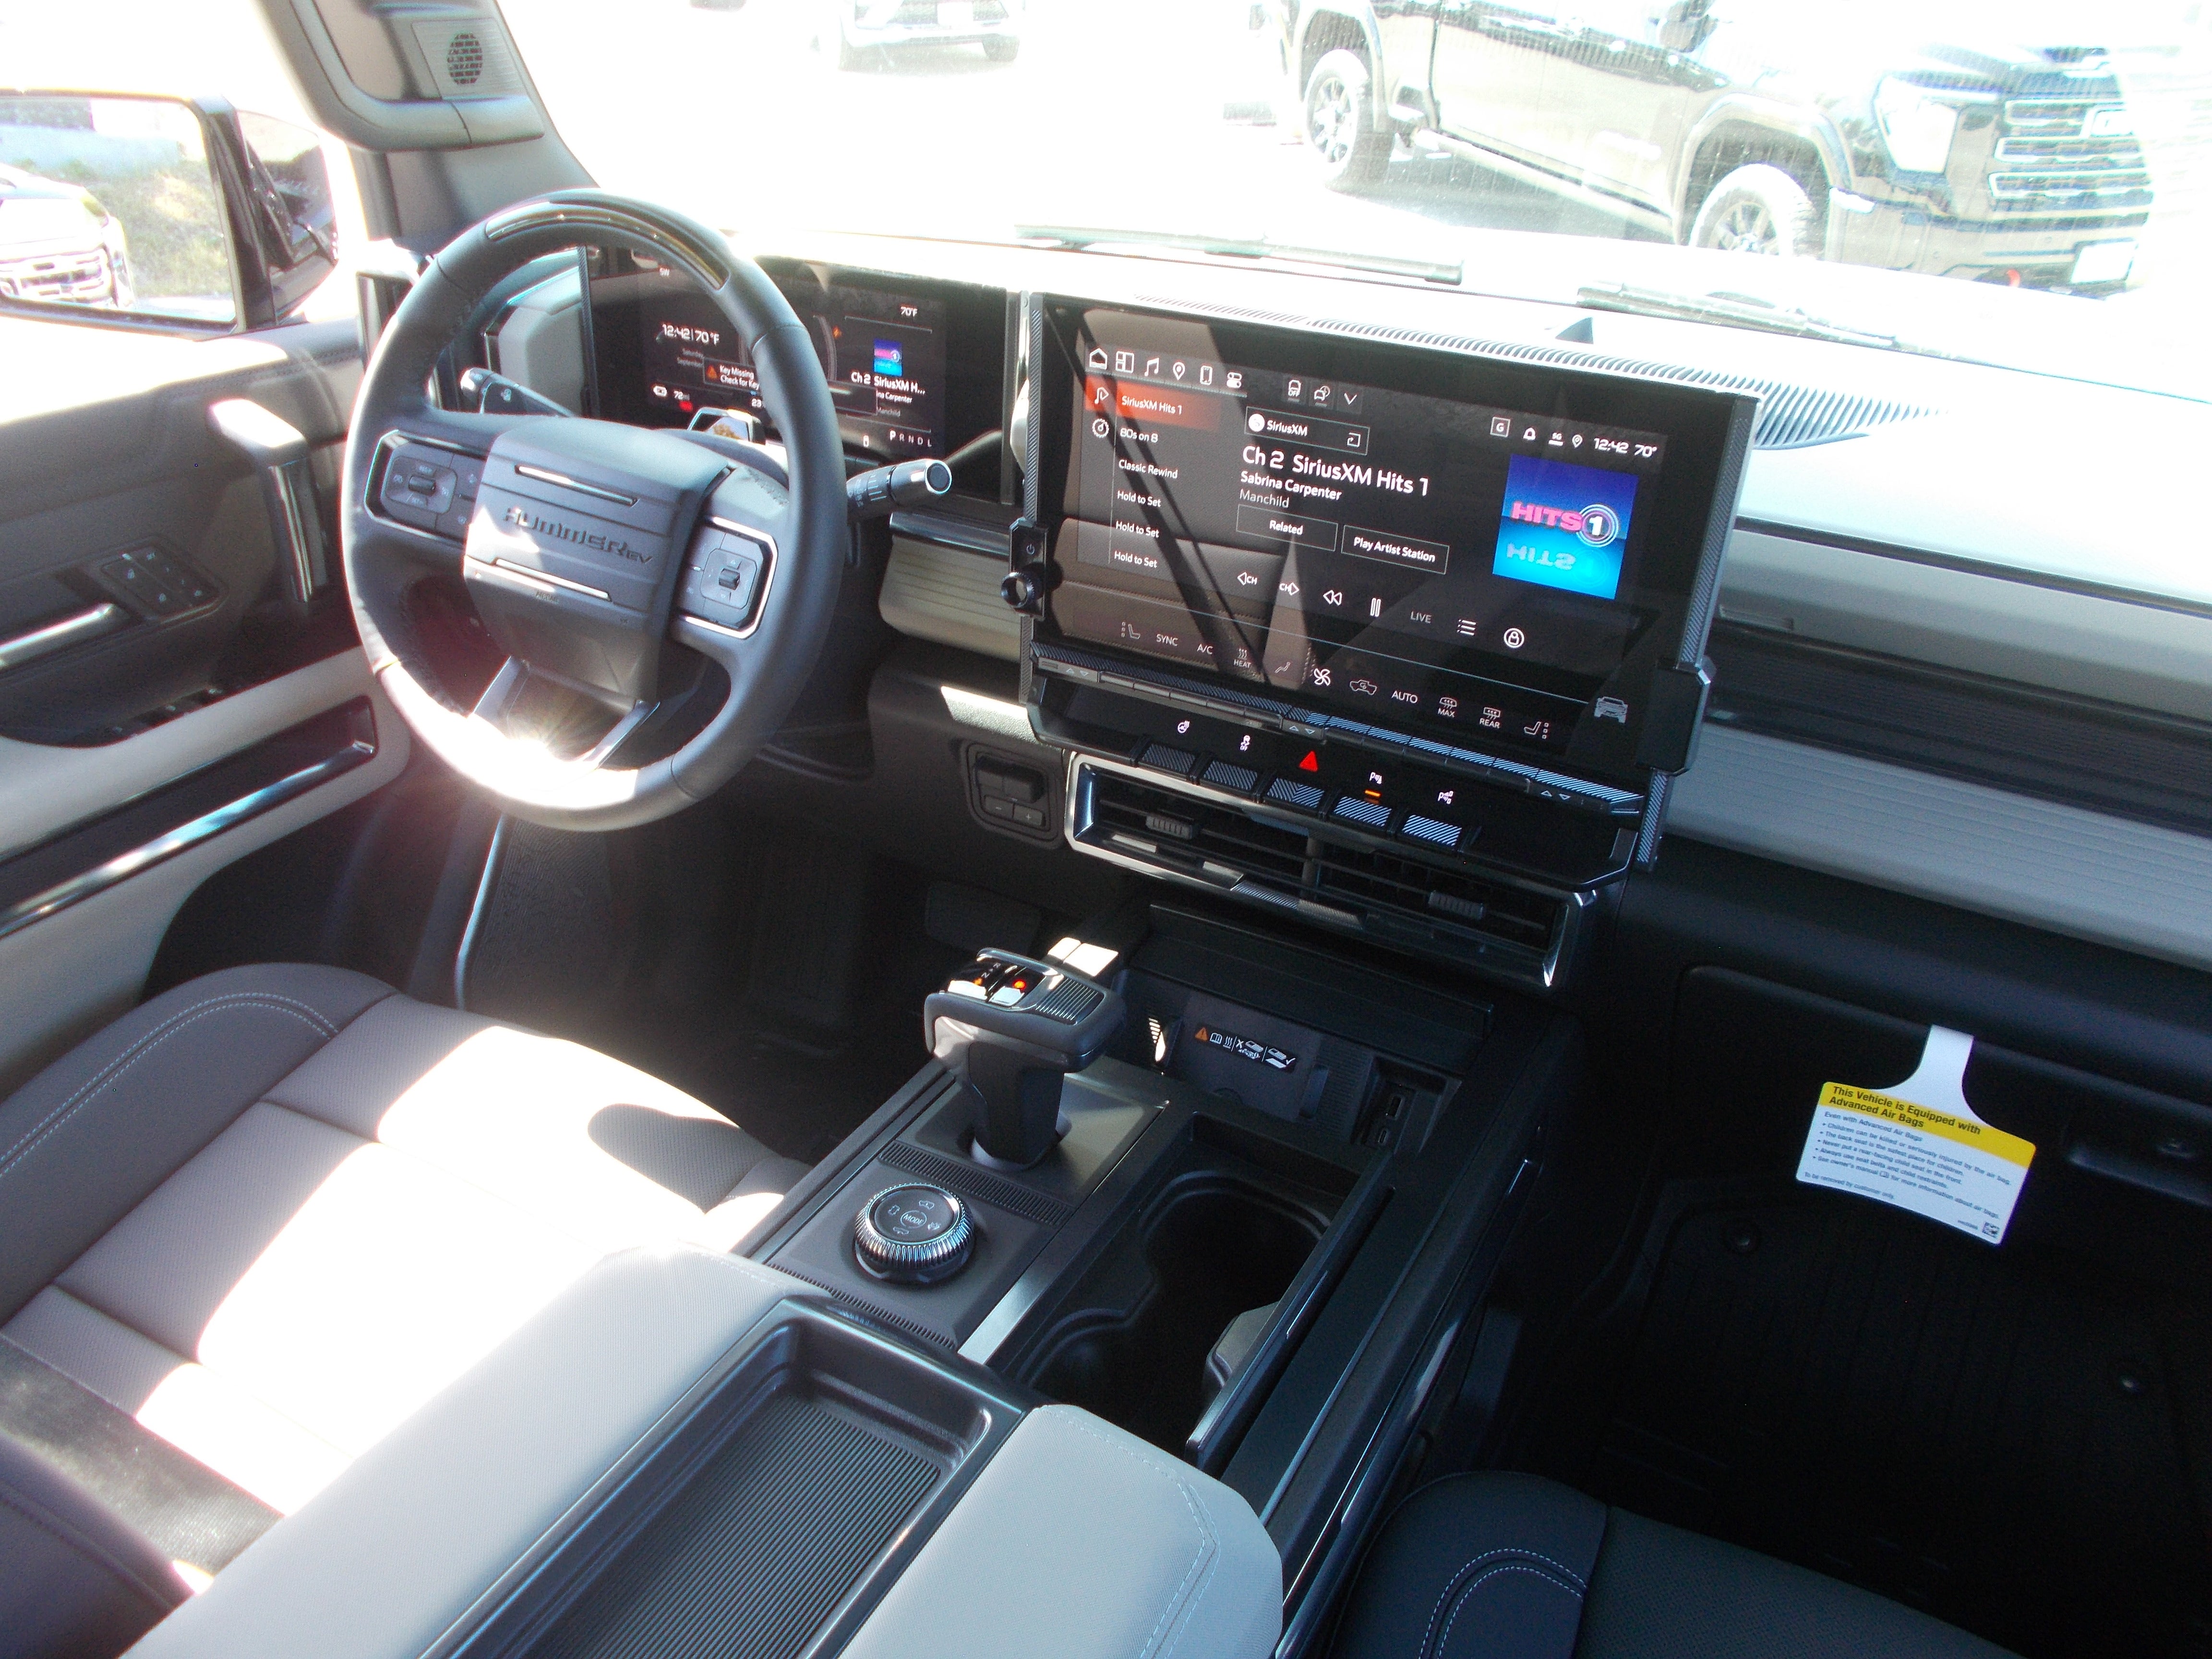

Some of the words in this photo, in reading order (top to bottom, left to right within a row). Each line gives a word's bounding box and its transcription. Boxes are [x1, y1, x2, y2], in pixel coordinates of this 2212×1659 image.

[720, 374, 738, 385] Check
[739, 377, 747, 386] for
[732, 367, 755, 380] Missing
[851, 372, 863, 383] Ch
[864, 374, 871, 384] 2
[874, 375, 909, 391] SiriusXM
[885, 392, 913, 403] Carpenter
[1121, 396, 1157, 411] SiriusXM
[1159, 400, 1176, 414] Hits
[1178, 404, 1182, 414] 1
[1120, 427, 1137, 440] 80s
[1139, 433, 1150, 442] on
[1151, 432, 1158, 443] 8
[1267, 419, 1308, 437] SiriusXM
[1496, 422, 1504, 432] G
[890, 430, 896, 441] P
[899, 433, 905, 442] R
[917, 437, 923, 445] D
[927, 439, 932, 447] L
[1594, 438, 1629, 454] 12:42
[1118, 458, 1146, 474] Classic
[1148, 463, 1178, 479] Rewind
[1243, 445, 1266, 466] Ch
[1270, 450, 1284, 469] 2
[1292, 454, 1371, 486] SiriusXM
[1377, 469, 1414, 494] Hits
[1419, 477, 1430, 497] 1
[1240, 471, 1282, 490] Sabrina
[1285, 480, 1342, 501] Carpenter
[1117, 490, 1135, 502] Hold
[1137, 494, 1145, 504] to
[1147, 495, 1161, 508] Set
[1239, 488, 1290, 508] Manchild
[1511, 501, 1583, 532] HITS
[1589, 515, 1603, 537] 1
[1116, 520, 1134, 533] Hold
[1135, 525, 1144, 536] to
[1145, 526, 1159, 538] Set
[1269, 520, 1304, 536] Related
[1353, 537, 1374, 553] Play
[1374, 541, 1401, 557] Artist
[1402, 547, 1436, 563] Station
[1114, 551, 1132, 563] Hold
[1133, 555, 1142, 565] to
[1143, 556, 1157, 568] Set
[1246, 576, 1258, 585] CH
[1410, 611, 1432, 625] LIVE
[1156, 634, 1178, 648] SYNC
[1197, 644, 1214, 655] A/C
[1234, 659, 1252, 669] HEAT
[1391, 690, 1418, 704] AUTO
[1438, 708, 1455, 718] MAX
[1479, 717, 1501, 729] REAR
[1829, 1096, 1879, 1114] Advanced
[1881, 1109, 1896, 1118] Air
[1899, 1114, 1924, 1128] Bags
[1833, 1086, 1853, 1097] This
[1857, 1091, 1893, 1107] Vehicle
[1896, 1101, 1904, 1110] is
[1907, 1105, 1956, 1126] Equipped
[1958, 1121, 1981, 1134] with
[1824, 1111, 1840, 1119] Even
[1859, 1119, 1892, 1132] Advanced
[1823, 1139, 1840, 1148] Never
[1841, 1144, 1852, 1152] put
[1827, 1123, 1854, 1133] Children
[1879, 1135, 1897, 1145] killed
[1908, 1144, 1937, 1158] seriously
[1939, 1154, 1962, 1166] injured
[1964, 1162, 1972, 1170] by
[1855, 1155, 1869, 1164] seat
[903, 1214, 925, 1225] MODE
